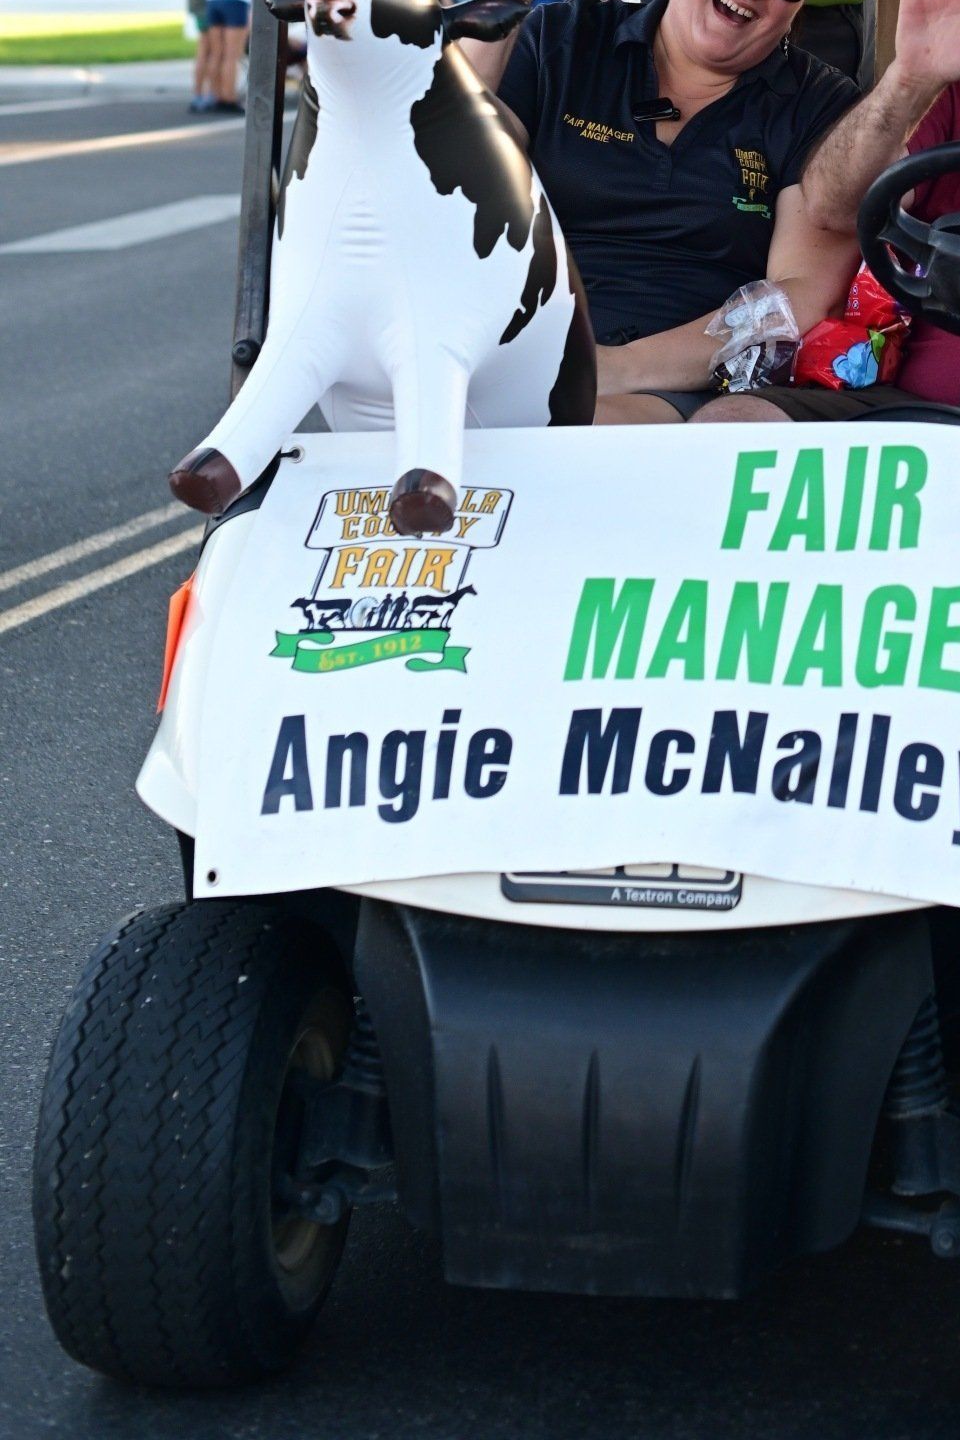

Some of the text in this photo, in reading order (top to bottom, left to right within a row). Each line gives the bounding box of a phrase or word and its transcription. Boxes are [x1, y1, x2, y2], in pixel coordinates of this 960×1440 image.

[563, 113, 634, 143] FAIR MANAGER
[579, 129, 610, 143] ANGIE
[334, 488, 503, 517] UMLA
[720, 444, 930, 553] FAIR
[328, 546, 458, 594] FAIR
[373, 635, 422, 659] 1912
[260, 708, 513, 824] Angie
[610, 888, 738, 909] A Textron Company
